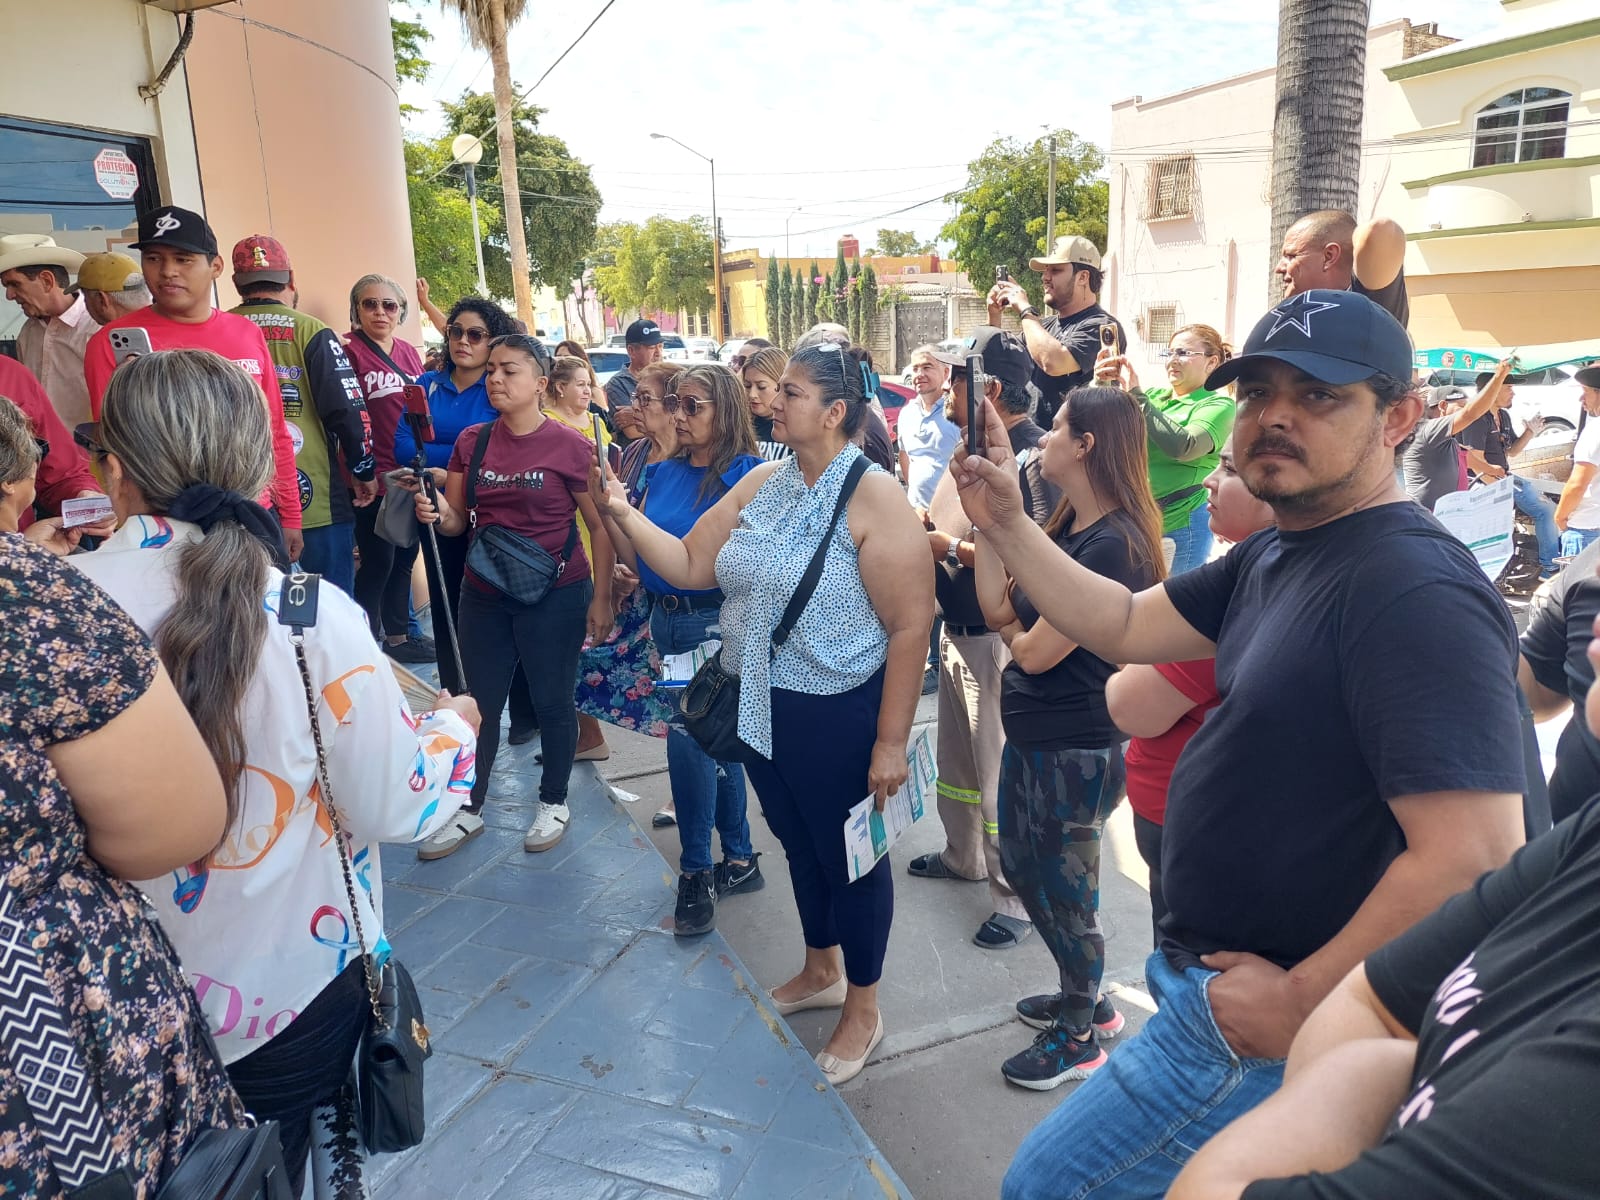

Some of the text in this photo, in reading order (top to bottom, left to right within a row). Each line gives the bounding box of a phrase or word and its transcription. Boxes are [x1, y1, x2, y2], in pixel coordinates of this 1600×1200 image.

[96, 160, 135, 173] PROTEGIDA
[243, 313, 289, 321] ADERAS
[262, 326, 295, 341] ASA
[476, 468, 544, 489] RMANI
